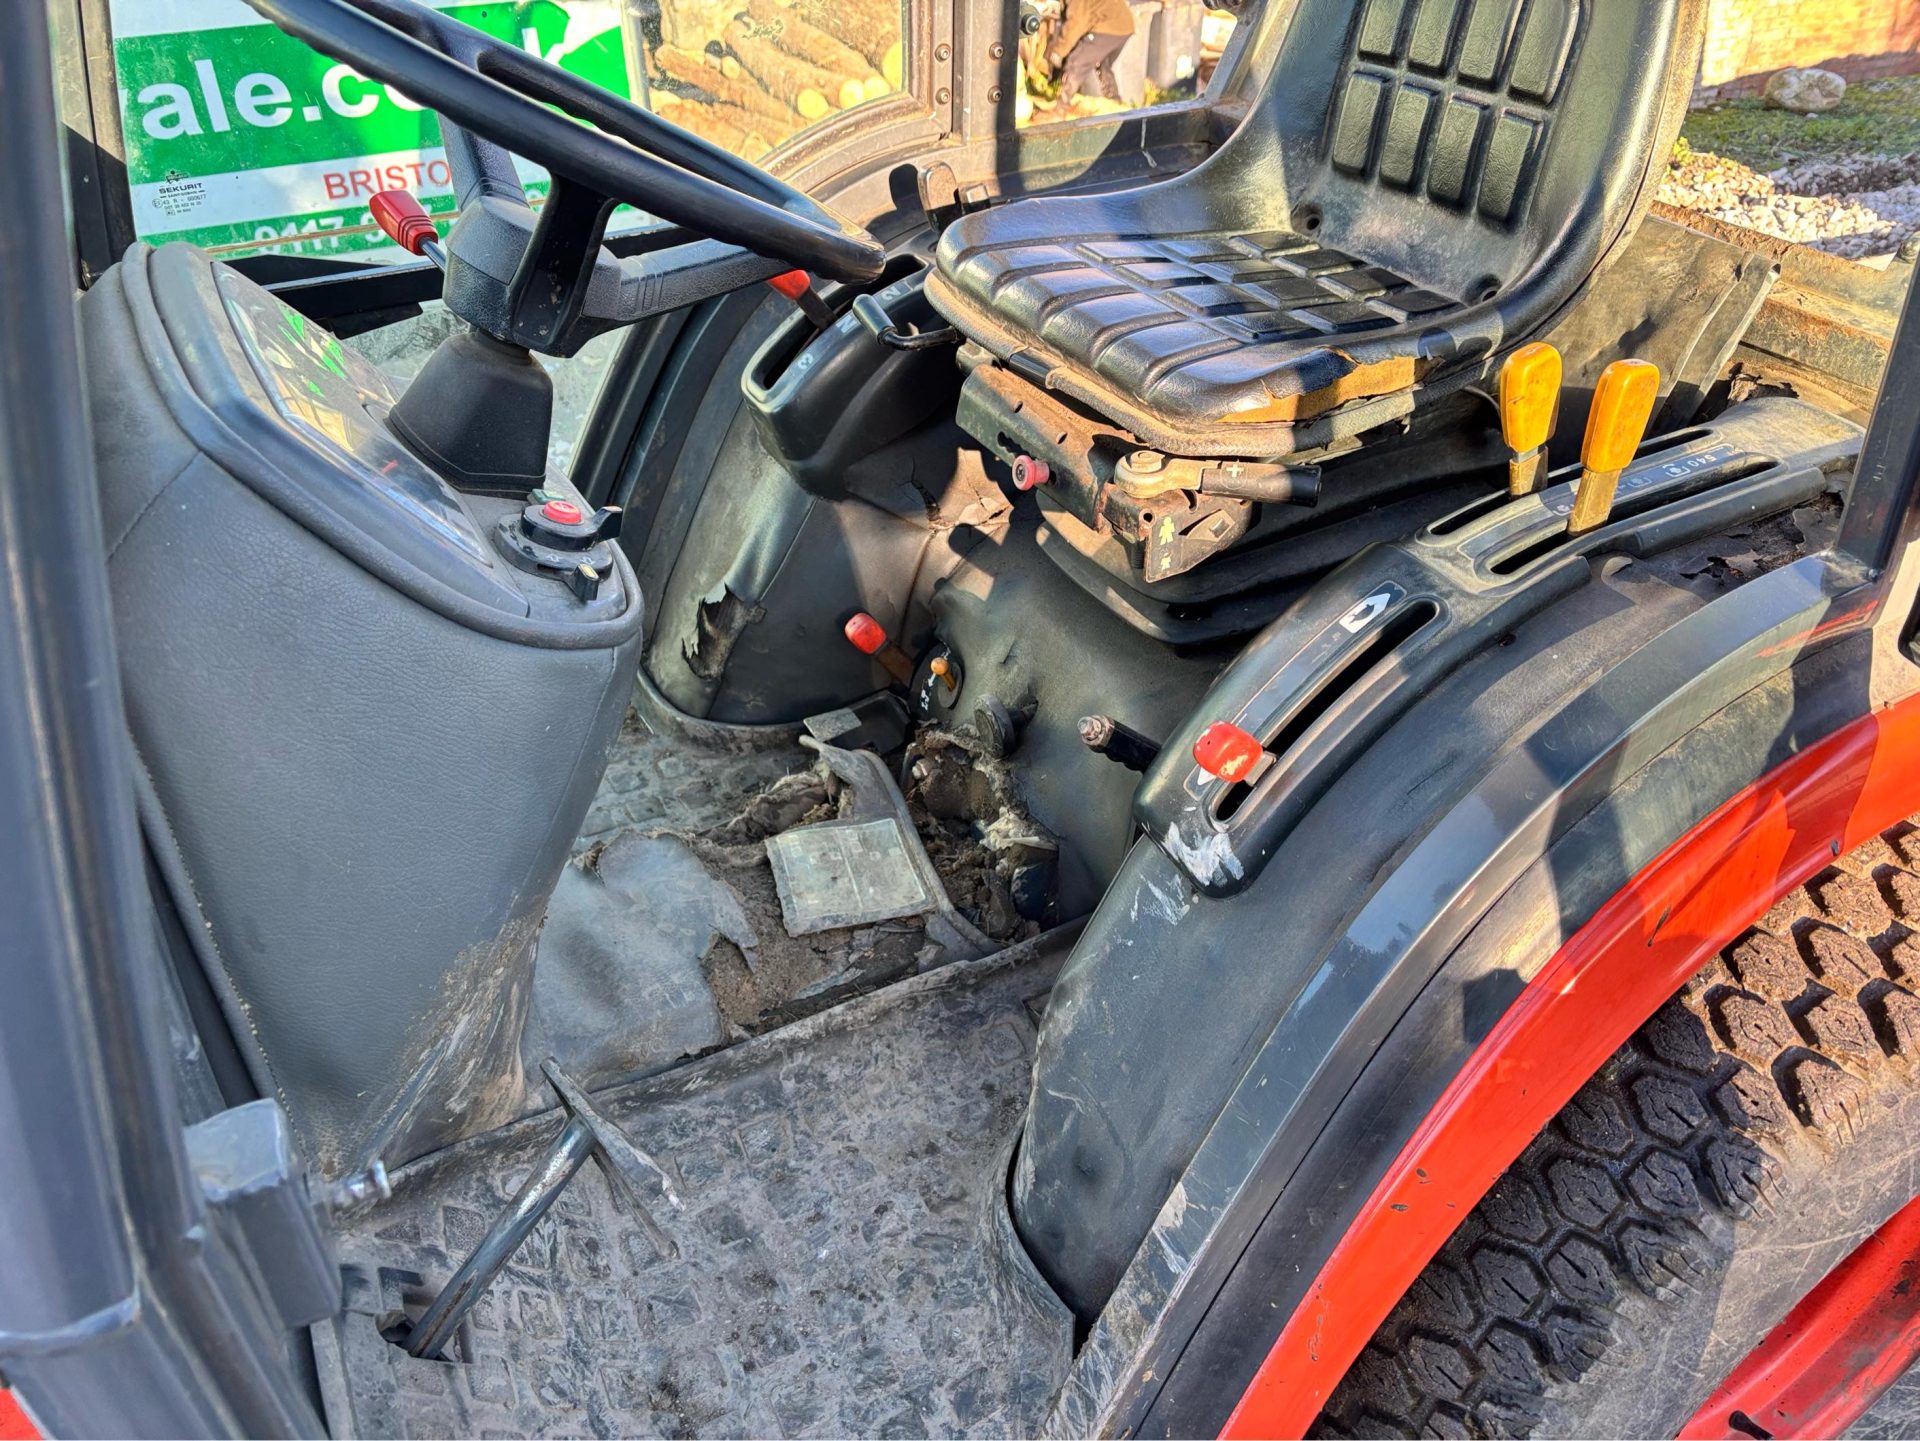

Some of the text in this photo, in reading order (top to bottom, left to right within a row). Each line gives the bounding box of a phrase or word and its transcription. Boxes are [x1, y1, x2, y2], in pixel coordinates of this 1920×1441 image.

[118, 58, 428, 140] ale.c
[159, 182, 203, 194] SEKURIT
[835, 314, 859, 334] N
[1687, 454, 1717, 467] 540
